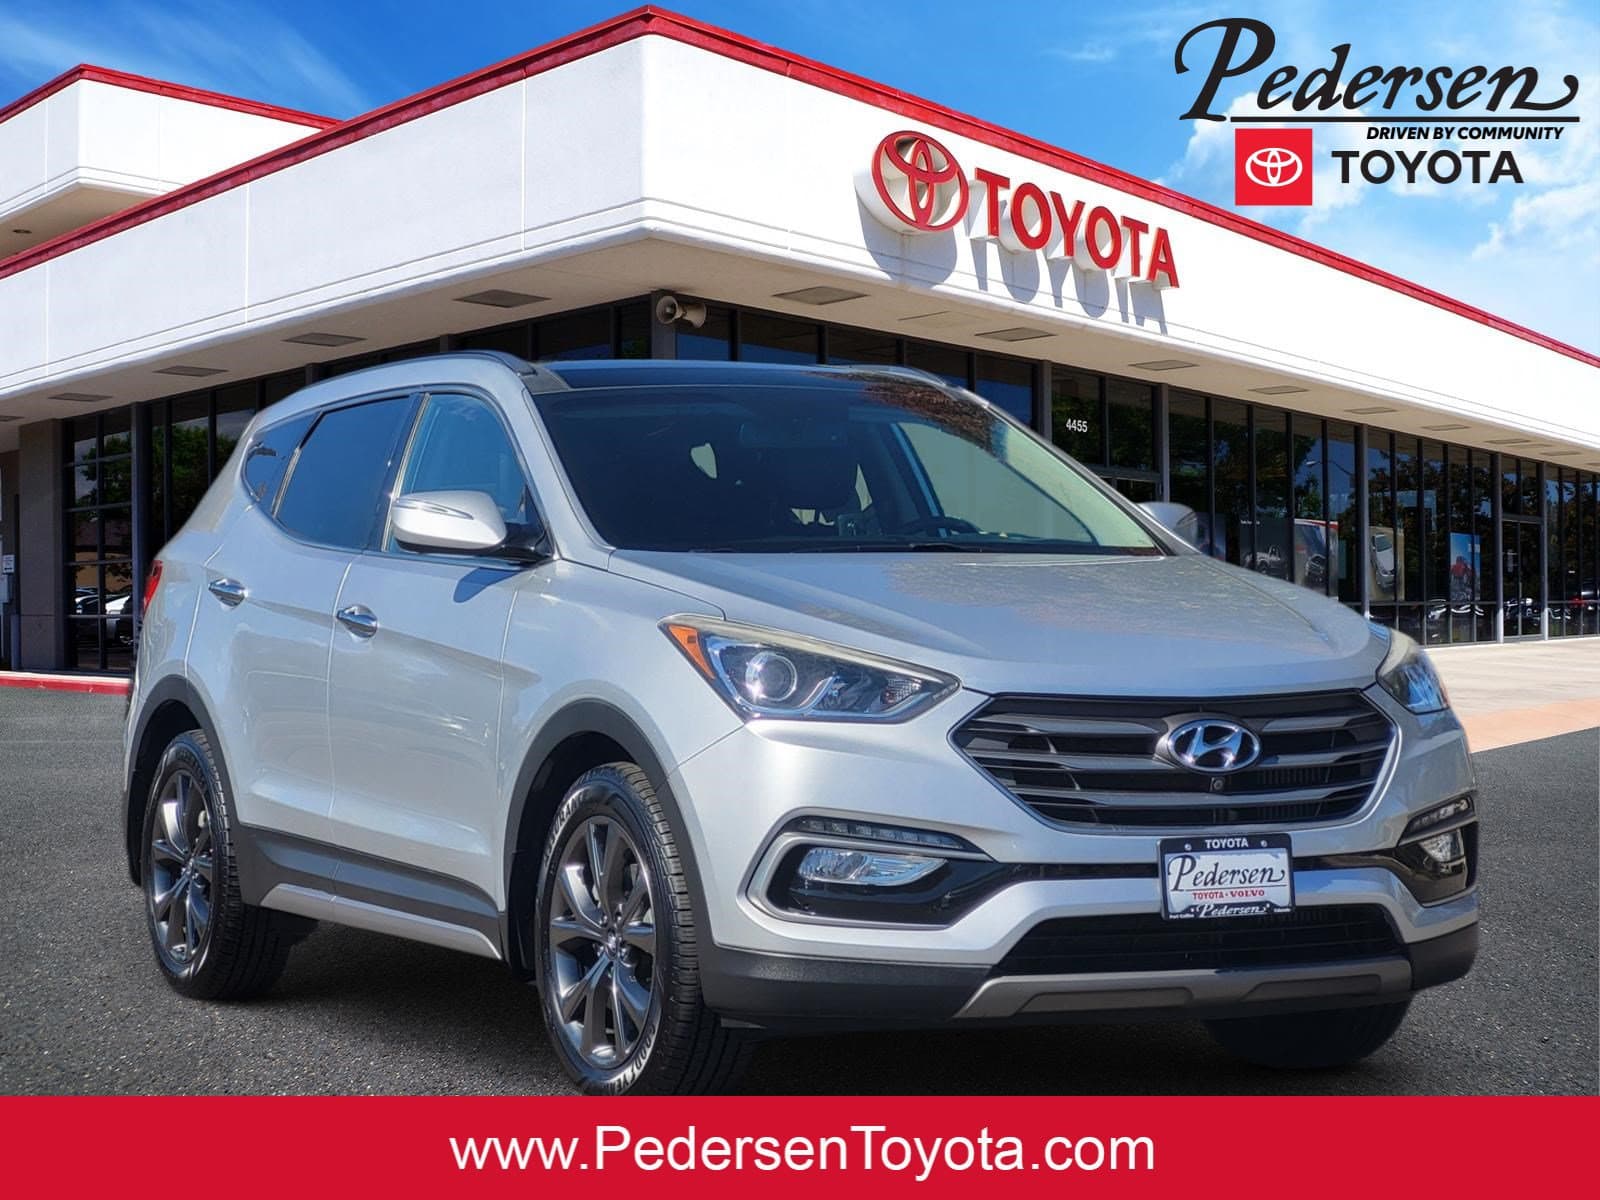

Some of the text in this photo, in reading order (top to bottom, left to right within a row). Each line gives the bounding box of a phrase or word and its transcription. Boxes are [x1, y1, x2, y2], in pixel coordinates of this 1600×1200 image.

[975, 167, 1180, 289] TOYOTA
[1066, 417, 1088, 433] 4455
[1204, 837, 1249, 849] TOYOTA
[1168, 854, 1286, 892] Pedersen
[1192, 889, 1265, 900] TOYOTA VOLVO
[1196, 903, 1267, 918] Pedersen
